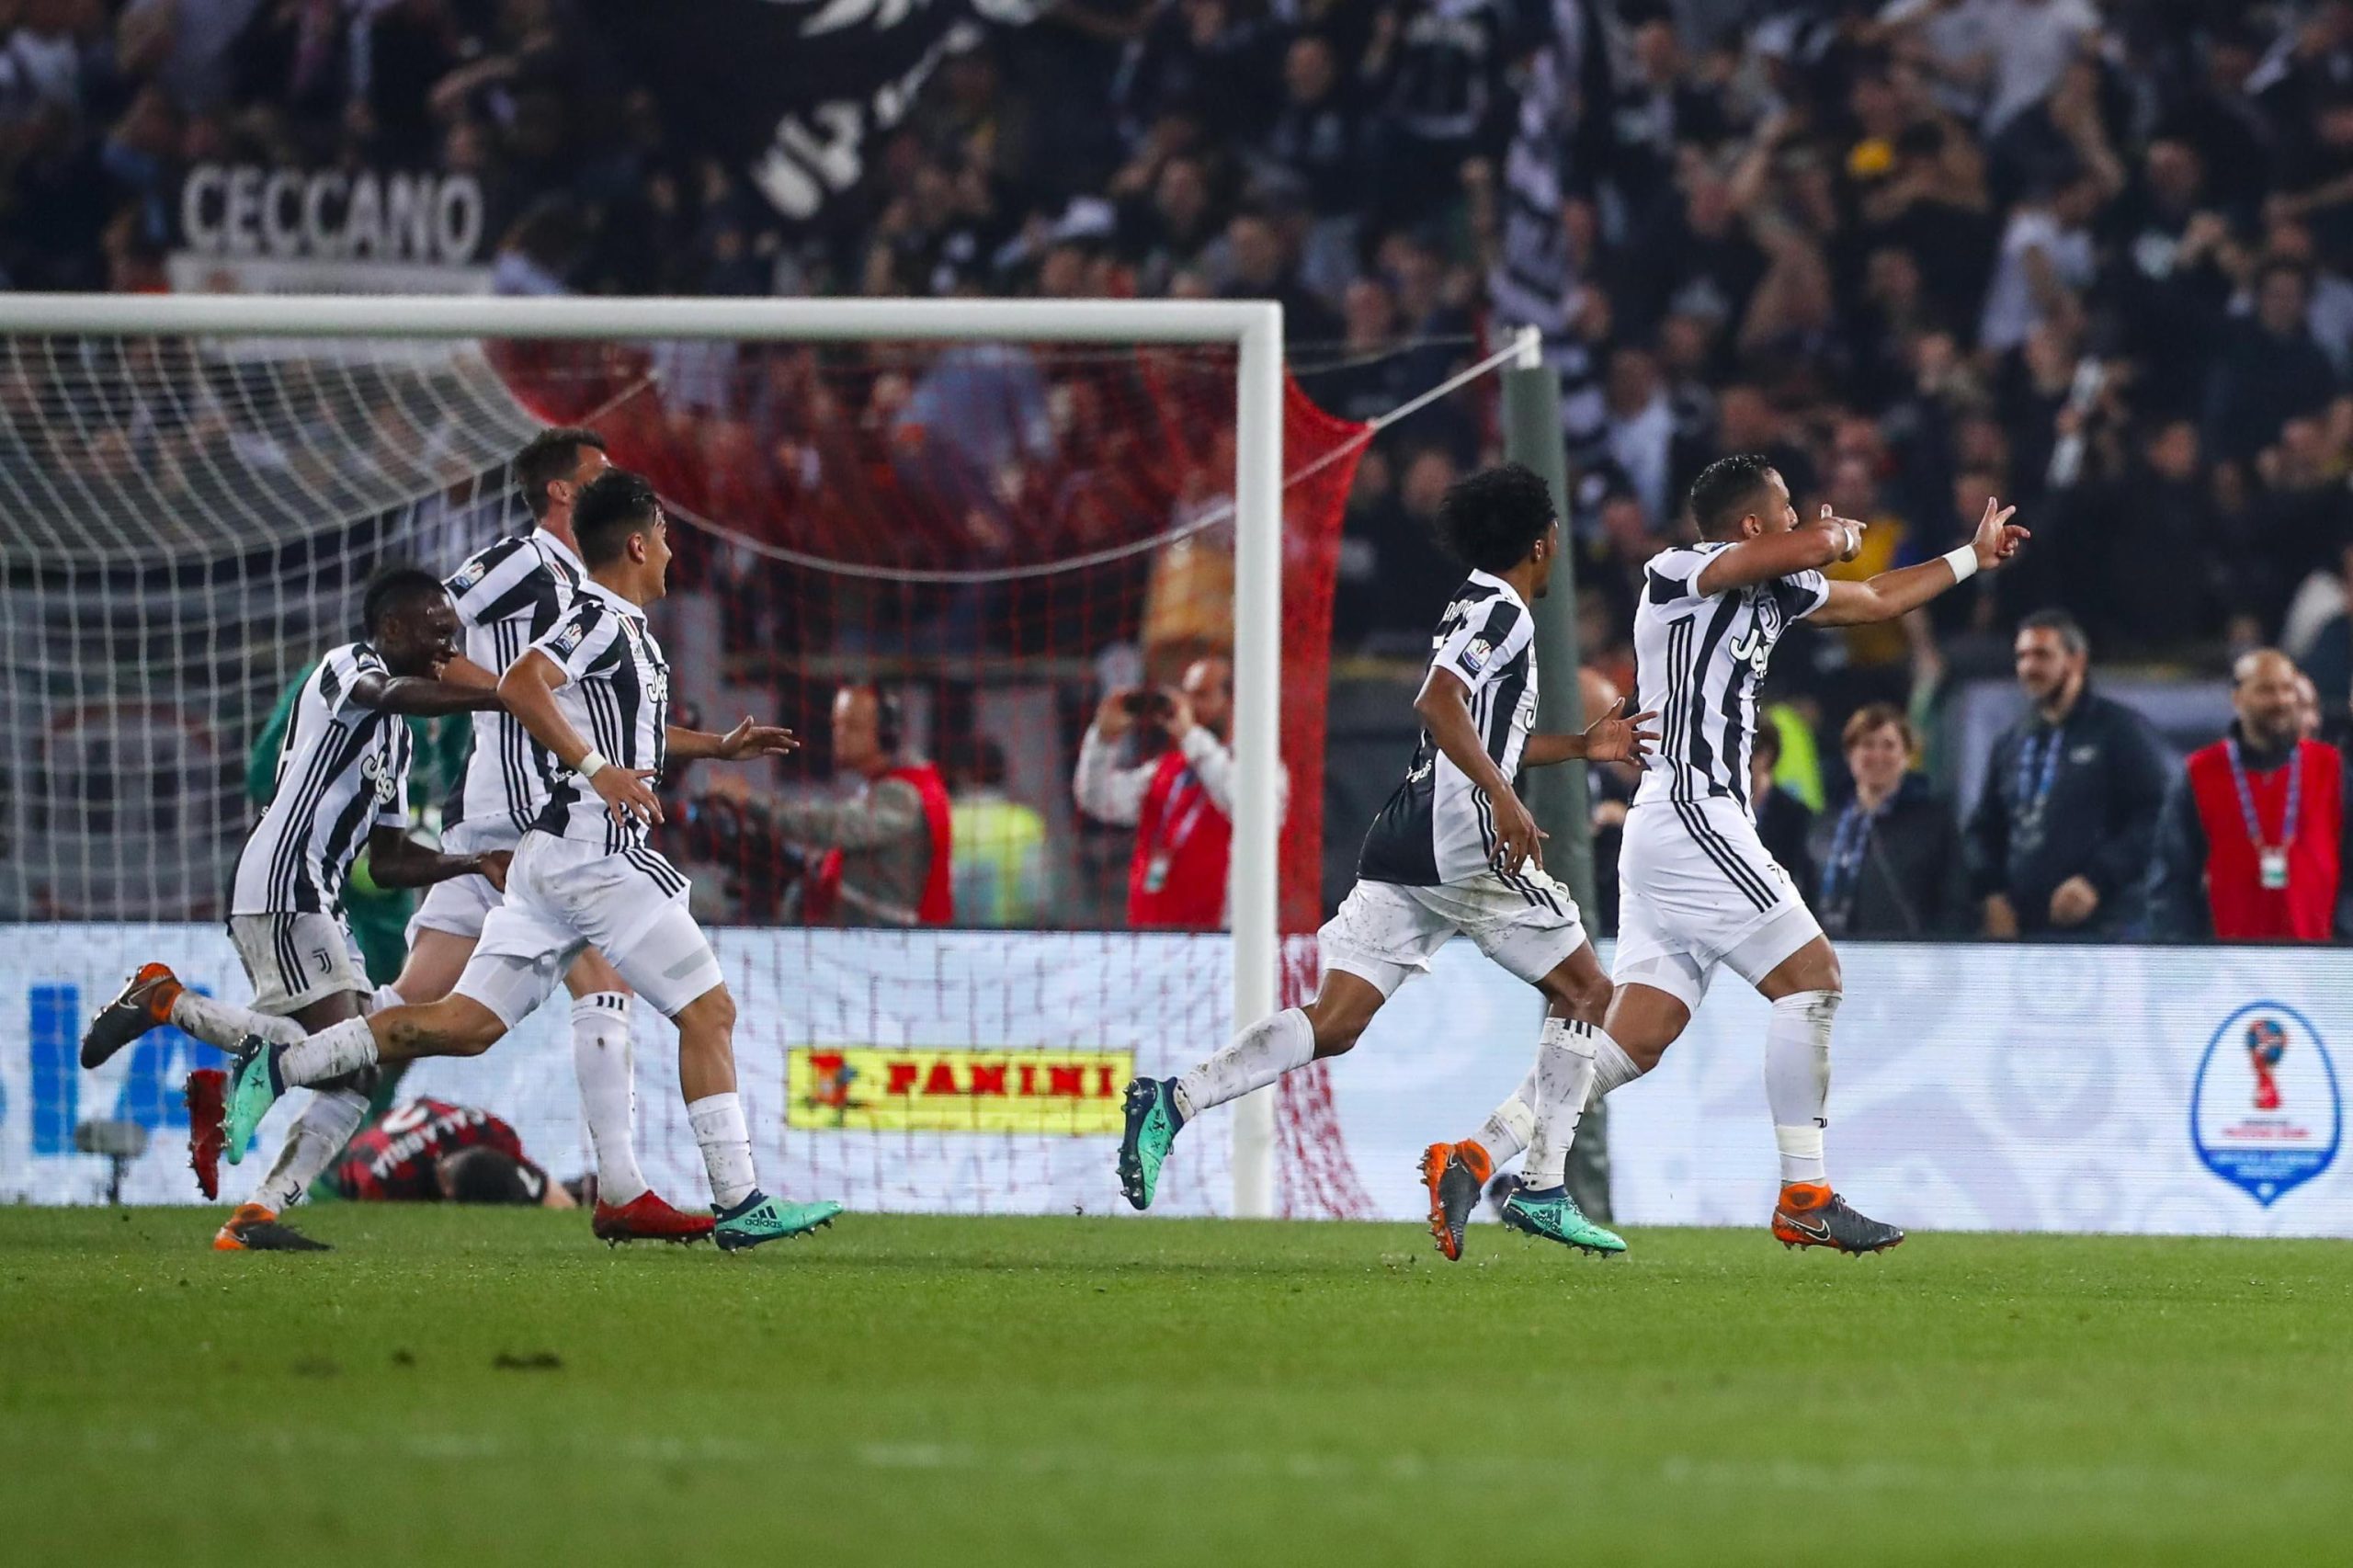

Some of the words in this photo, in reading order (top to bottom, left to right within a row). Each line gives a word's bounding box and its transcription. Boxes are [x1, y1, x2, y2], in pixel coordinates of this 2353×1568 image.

[182, 161, 483, 266] CECCANO
[886, 1060, 1114, 1097] PANINI
[745, 1217, 783, 1229] adidas
